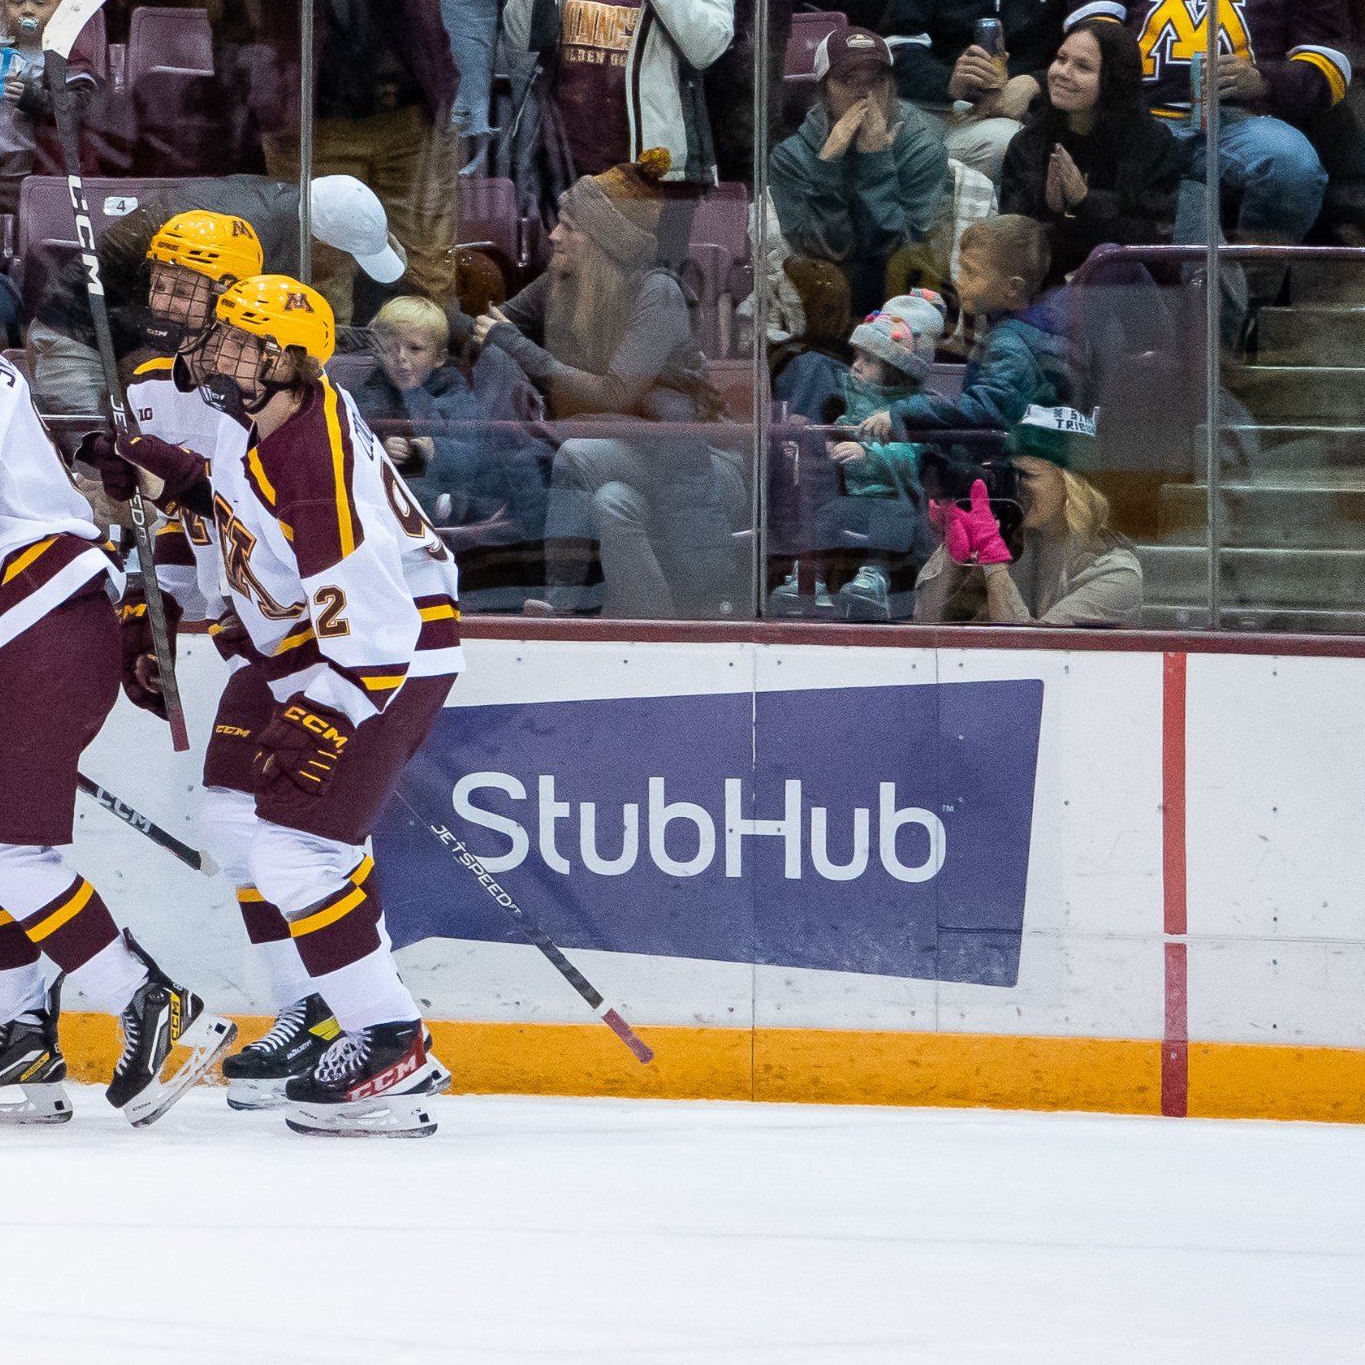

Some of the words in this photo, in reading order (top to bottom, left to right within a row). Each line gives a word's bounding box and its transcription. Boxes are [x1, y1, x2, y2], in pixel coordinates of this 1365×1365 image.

[115, 200, 126, 212] 4
[67, 174, 105, 296] CCM
[232, 220, 254, 239] M
[282, 291, 314, 313] M
[314, 585, 350, 638] 2
[215, 724, 250, 738] CCM
[283, 705, 347, 749] CCM
[93, 786, 152, 833] CCM
[452, 771, 948, 884] StubHub
[429, 823, 512, 908] JETSPEED
[170, 1000, 181, 1041] CCM
[347, 1055, 419, 1102] CCM
